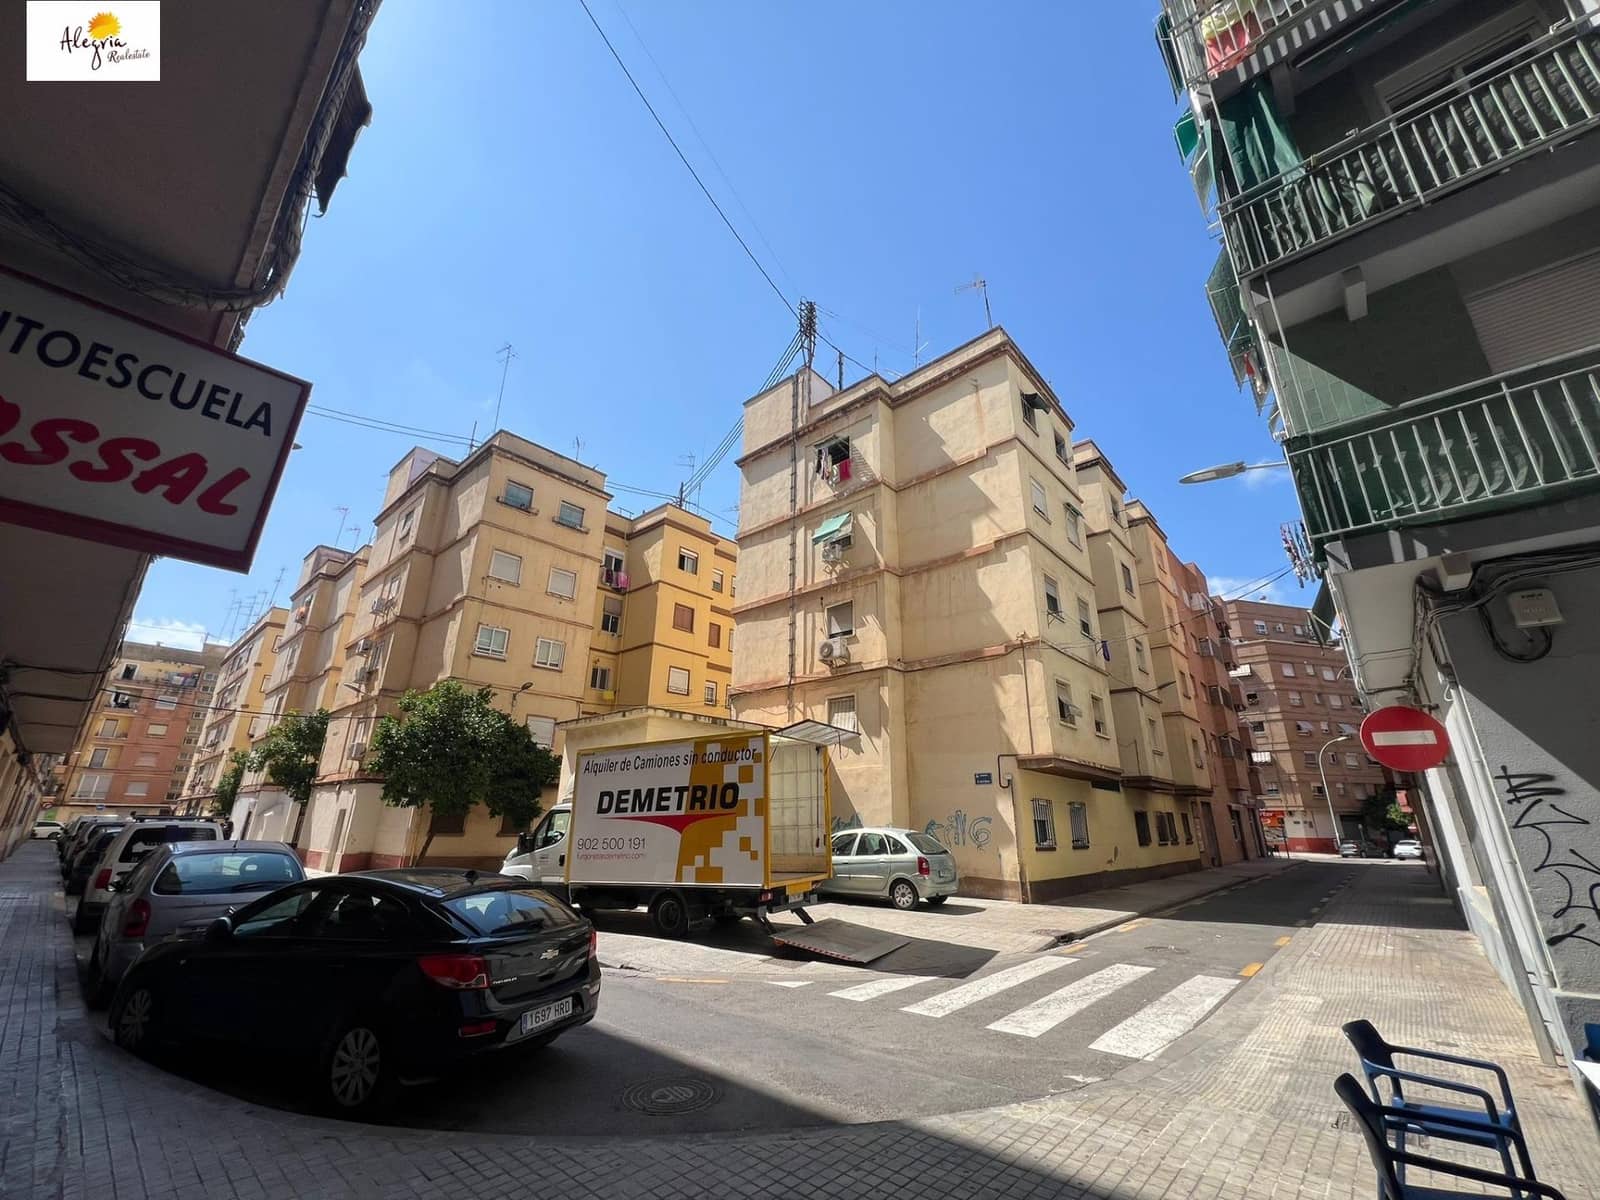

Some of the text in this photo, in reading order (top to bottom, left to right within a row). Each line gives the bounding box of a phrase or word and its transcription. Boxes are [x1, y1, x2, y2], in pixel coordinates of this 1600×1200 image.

[584, 747, 757, 776] Alquiler de Camiones sin conductor
[596, 782, 740, 815] DEMETRIO
[577, 836, 646, 850] 902 500 191
[530, 1001, 570, 1026] 1697 HRD
